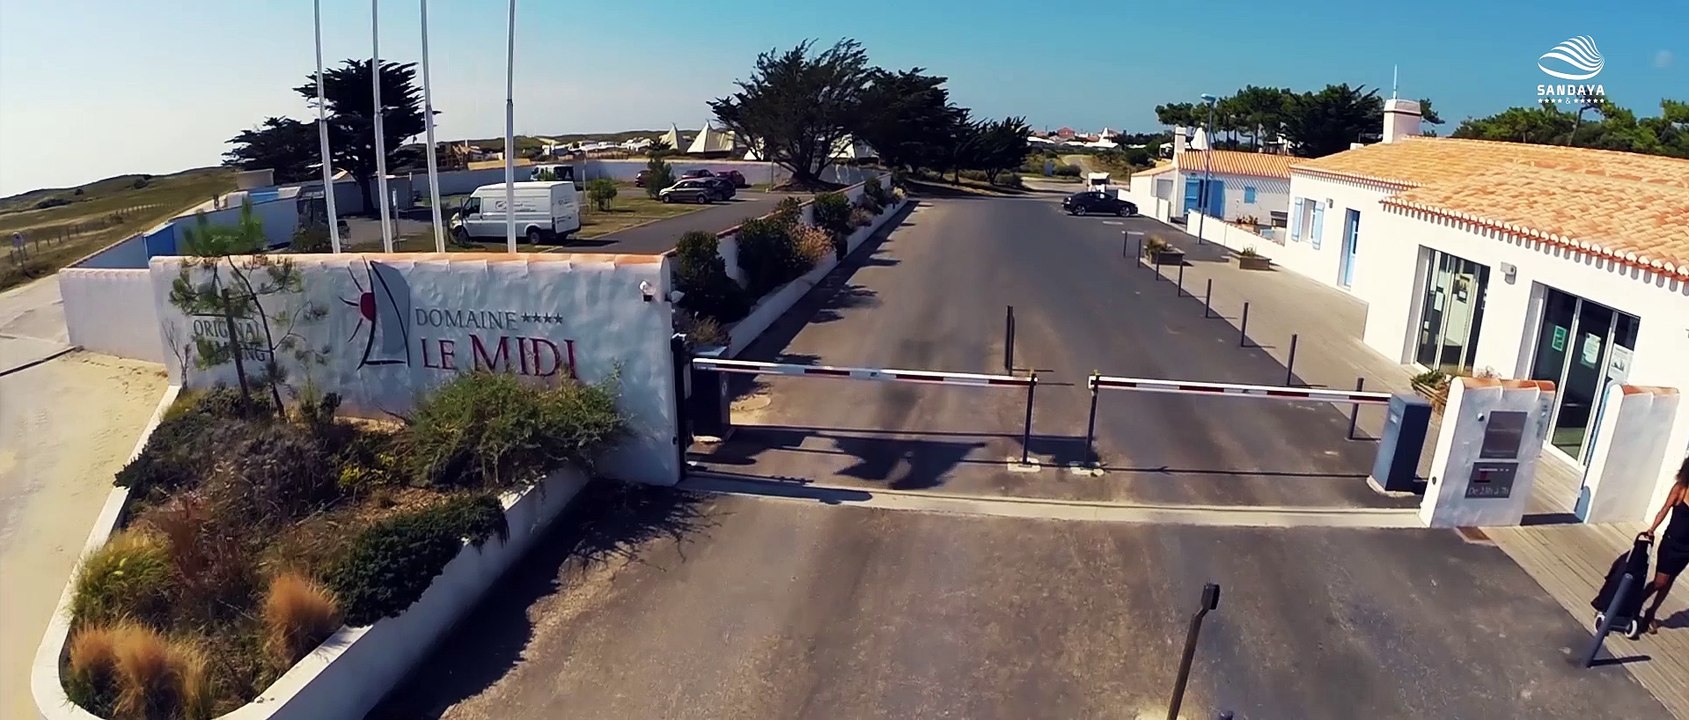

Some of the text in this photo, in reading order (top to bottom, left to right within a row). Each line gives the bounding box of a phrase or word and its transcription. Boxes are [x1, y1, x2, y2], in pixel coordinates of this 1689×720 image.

[415, 307, 518, 330] DOMAINE
[420, 333, 578, 380] LE MIDI
